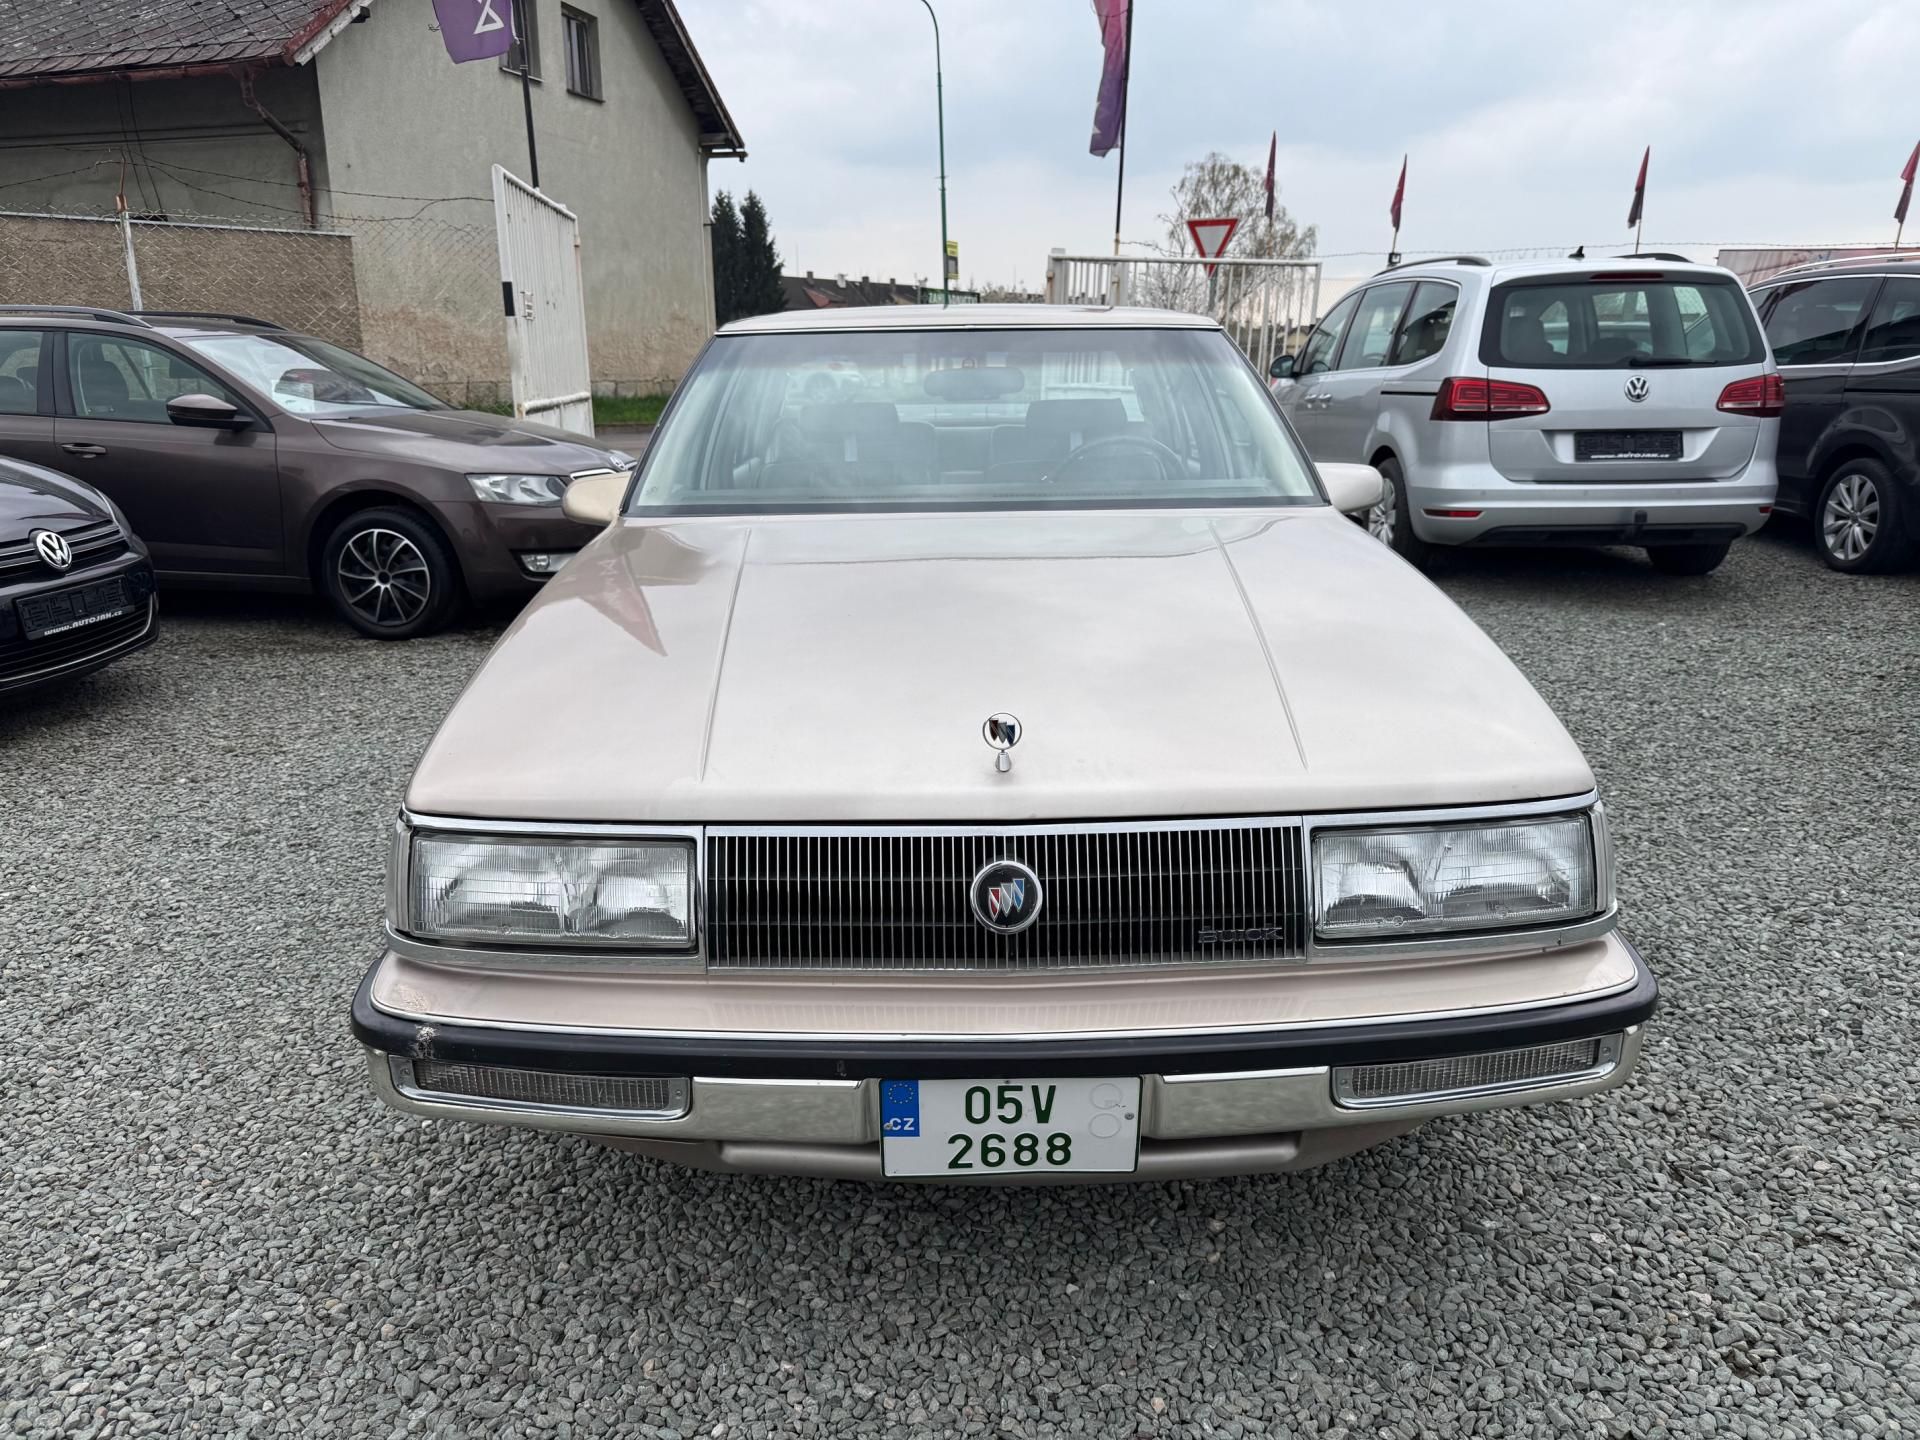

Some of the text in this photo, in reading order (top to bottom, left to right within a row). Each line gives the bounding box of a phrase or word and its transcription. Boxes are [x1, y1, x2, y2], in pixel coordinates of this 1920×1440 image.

[1198, 927, 1284, 944] BUICK
[964, 1085, 1057, 1125] 05V
[890, 1117, 915, 1131] CZ
[947, 1132, 1073, 1169] 2688
